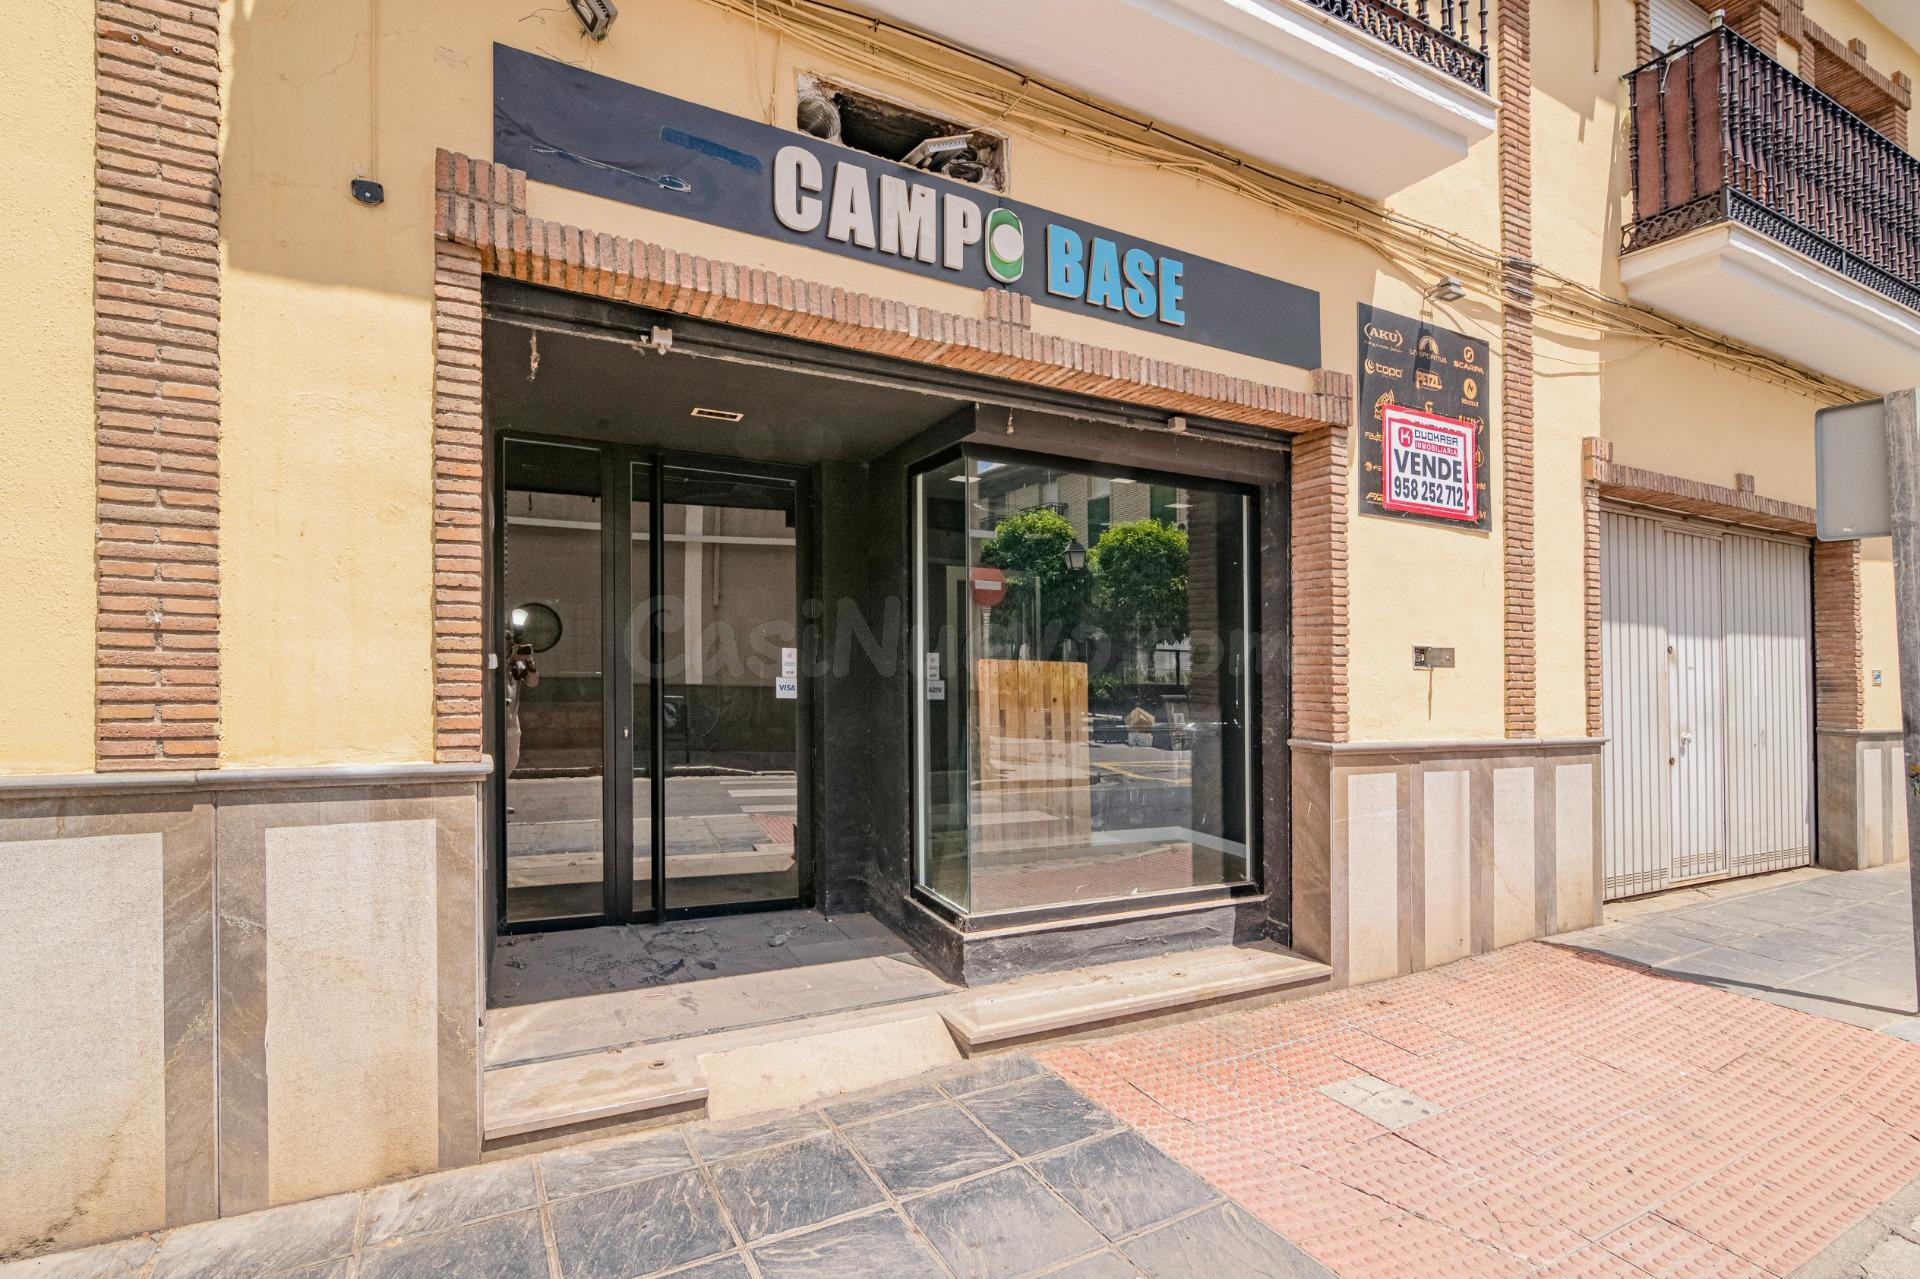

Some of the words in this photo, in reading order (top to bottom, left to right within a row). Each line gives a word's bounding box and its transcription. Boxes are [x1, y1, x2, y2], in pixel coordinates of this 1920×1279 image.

[773, 145, 1025, 283] CAMPO
[1046, 223, 1187, 326] BASE
[1369, 327, 1399, 343] AKU
[1453, 360, 1485, 375] SCARPA
[1414, 429, 1459, 446] DUOKASA
[1415, 441, 1458, 457] INMOBILIARIA
[1393, 448, 1463, 484] VENDE
[1394, 475, 1418, 500] 958
[1421, 480, 1443, 504] 252
[1445, 483, 1464, 507] 712
